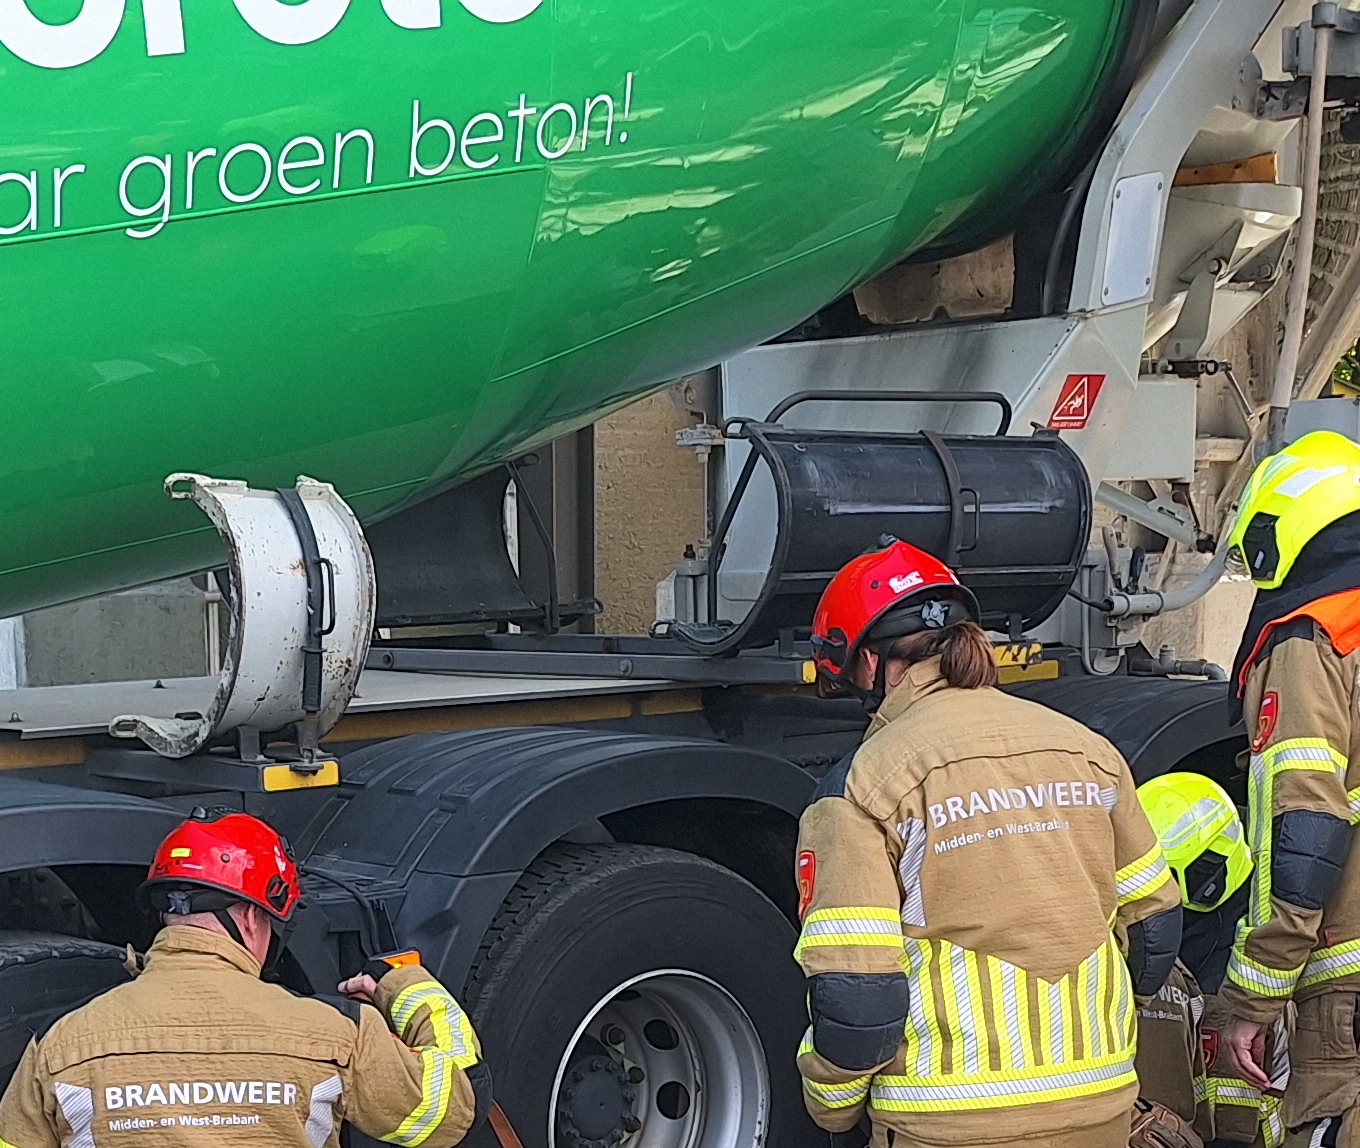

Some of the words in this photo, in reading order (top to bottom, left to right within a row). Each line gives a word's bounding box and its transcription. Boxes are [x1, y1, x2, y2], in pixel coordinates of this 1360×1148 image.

[119, 127, 375, 238] groen
[408, 72, 635, 178] beton!
[928, 781, 1102, 829] BRANDWEER
[933, 832, 984, 855] Midden-
[987, 826, 1004, 839] en
[105, 1081, 297, 1110] BRANDWEER
[108, 1120, 158, 1132] Midden-
[160, 1117, 176, 1127] en
[178, 1114, 260, 1127] West-Brabant
